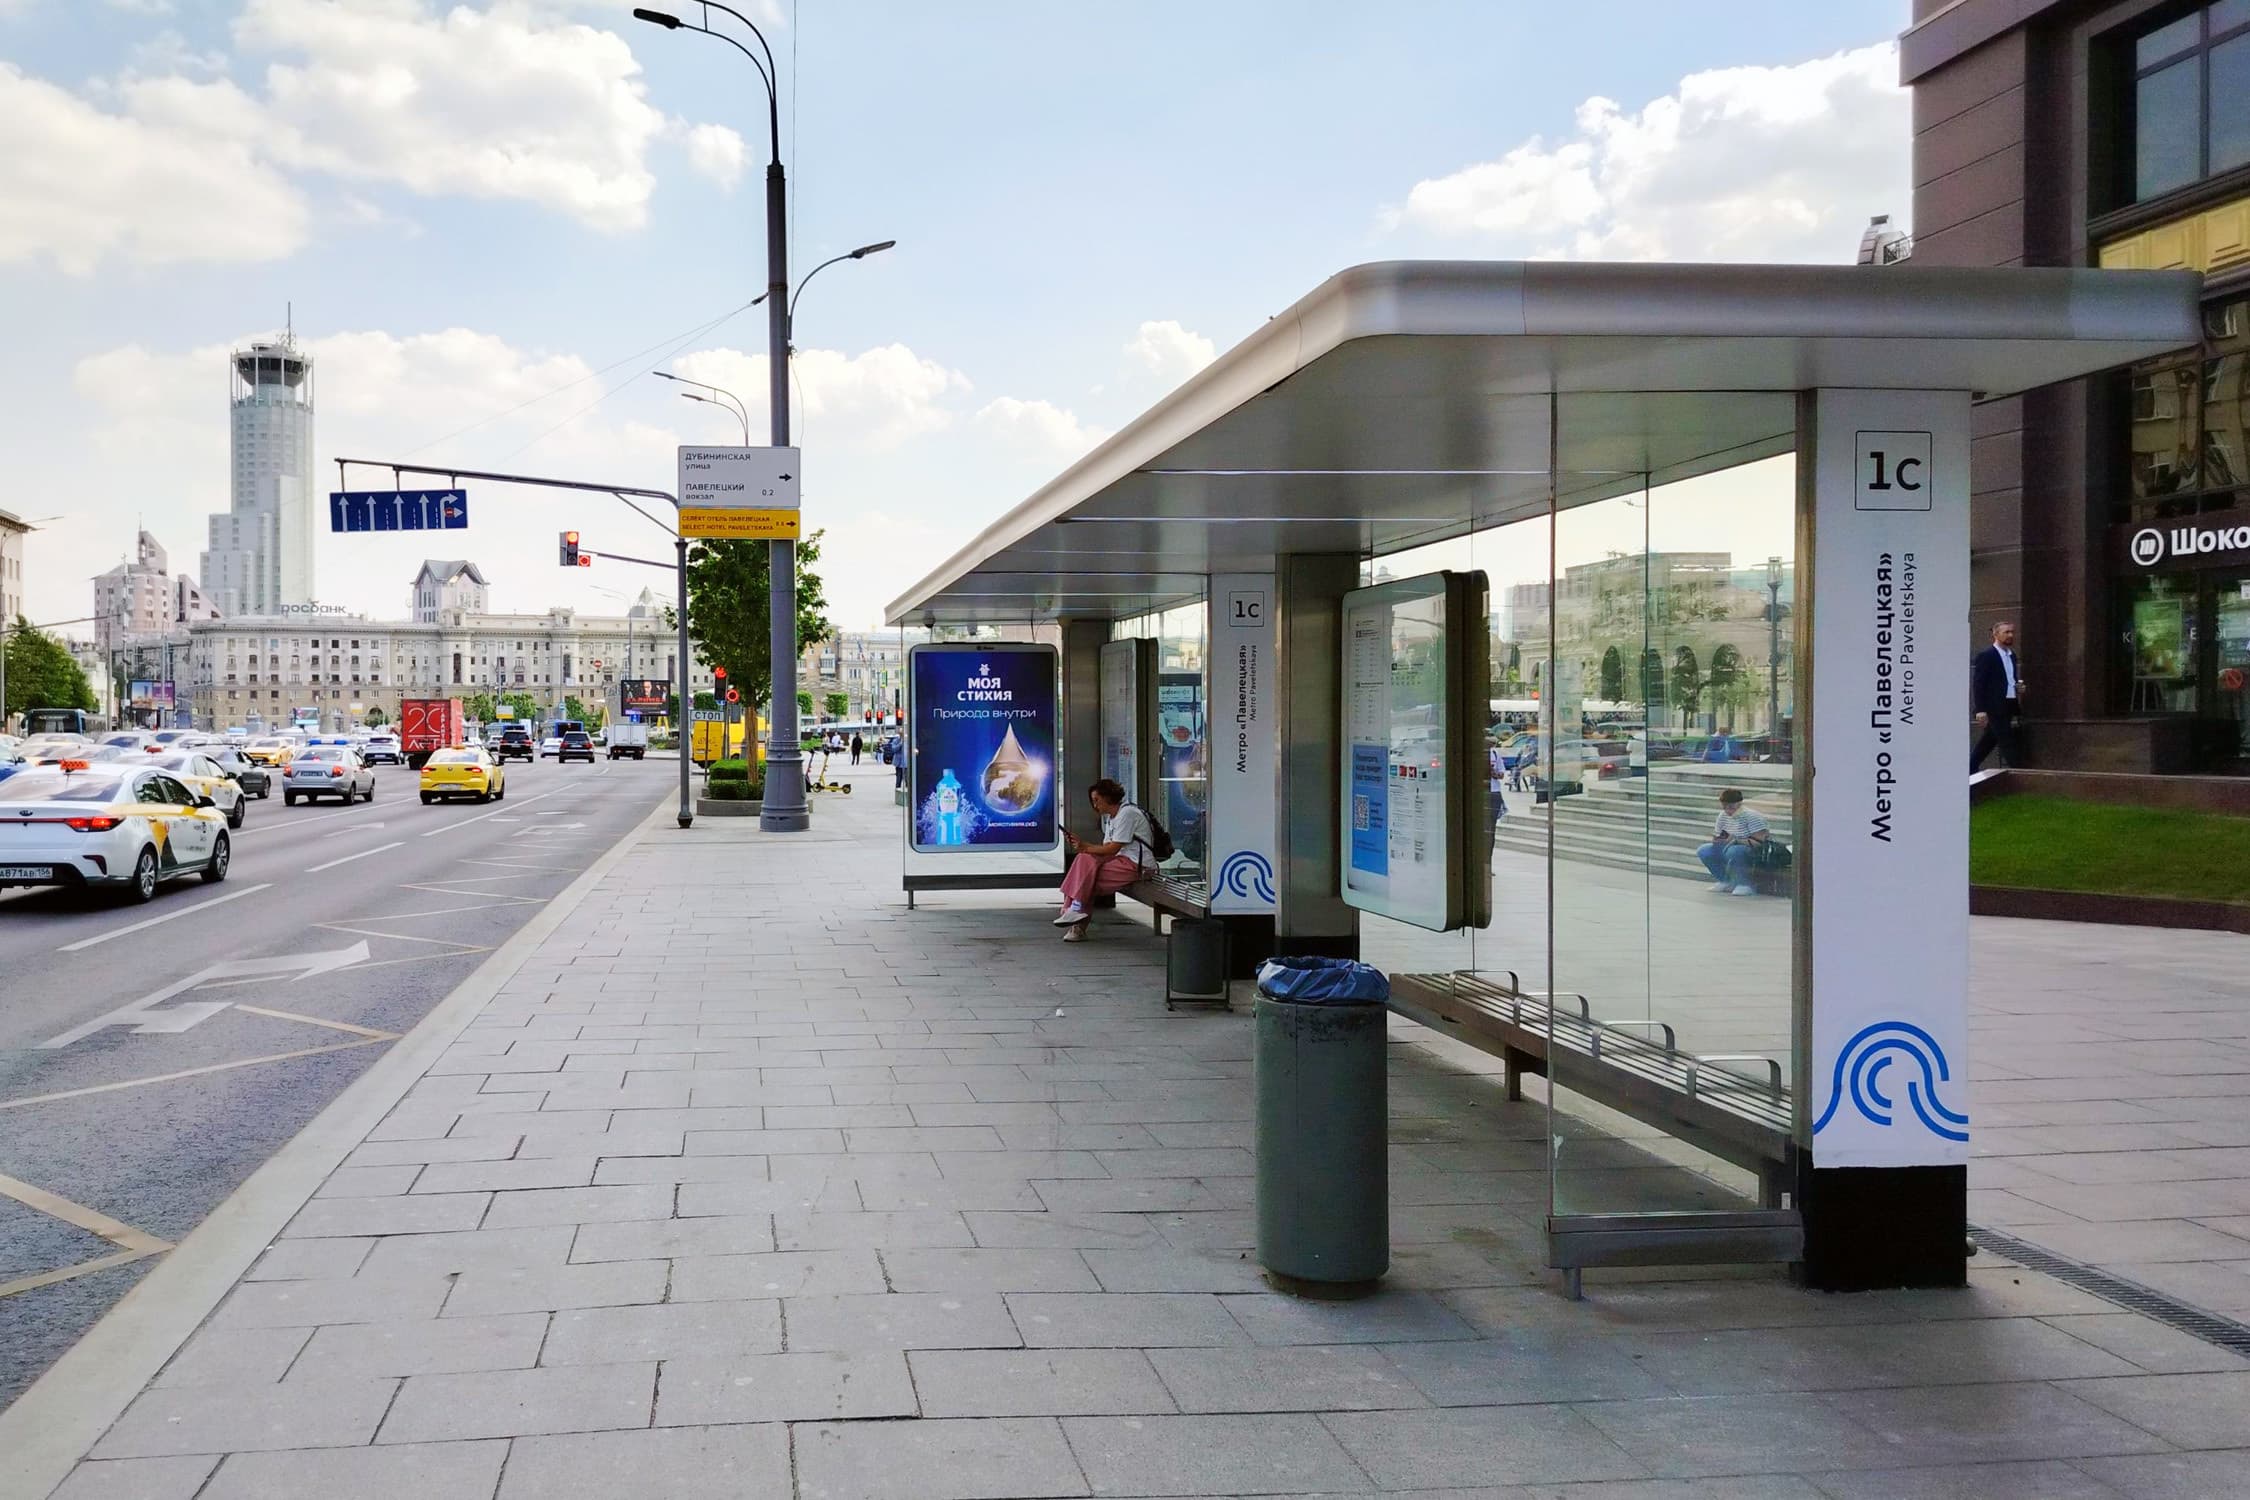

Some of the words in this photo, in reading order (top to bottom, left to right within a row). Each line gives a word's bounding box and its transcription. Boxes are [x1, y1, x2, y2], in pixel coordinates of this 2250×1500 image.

[685, 453, 751, 461] ДУБИНИНСКАЯ
[685, 483, 745, 492] ПАВЕЛЕЦКИЙ
[281, 600, 346, 616] росбанк
[1900, 552, 1916, 664] Paveletskaya
[1871, 552, 1895, 743] «Павелецкая»
[968, 677, 1001, 689] МОЯ
[1236, 645, 1248, 730] «Павелецкая»
[957, 690, 1012, 701] СТИХИЯ
[1900, 670, 1914, 725] Metro
[695, 711, 721, 720] СТОП
[933, 708, 990, 719] Природа
[992, 709, 1037, 719] внутри
[1237, 733, 1248, 773] Метро
[1871, 750, 1896, 842] Метро
